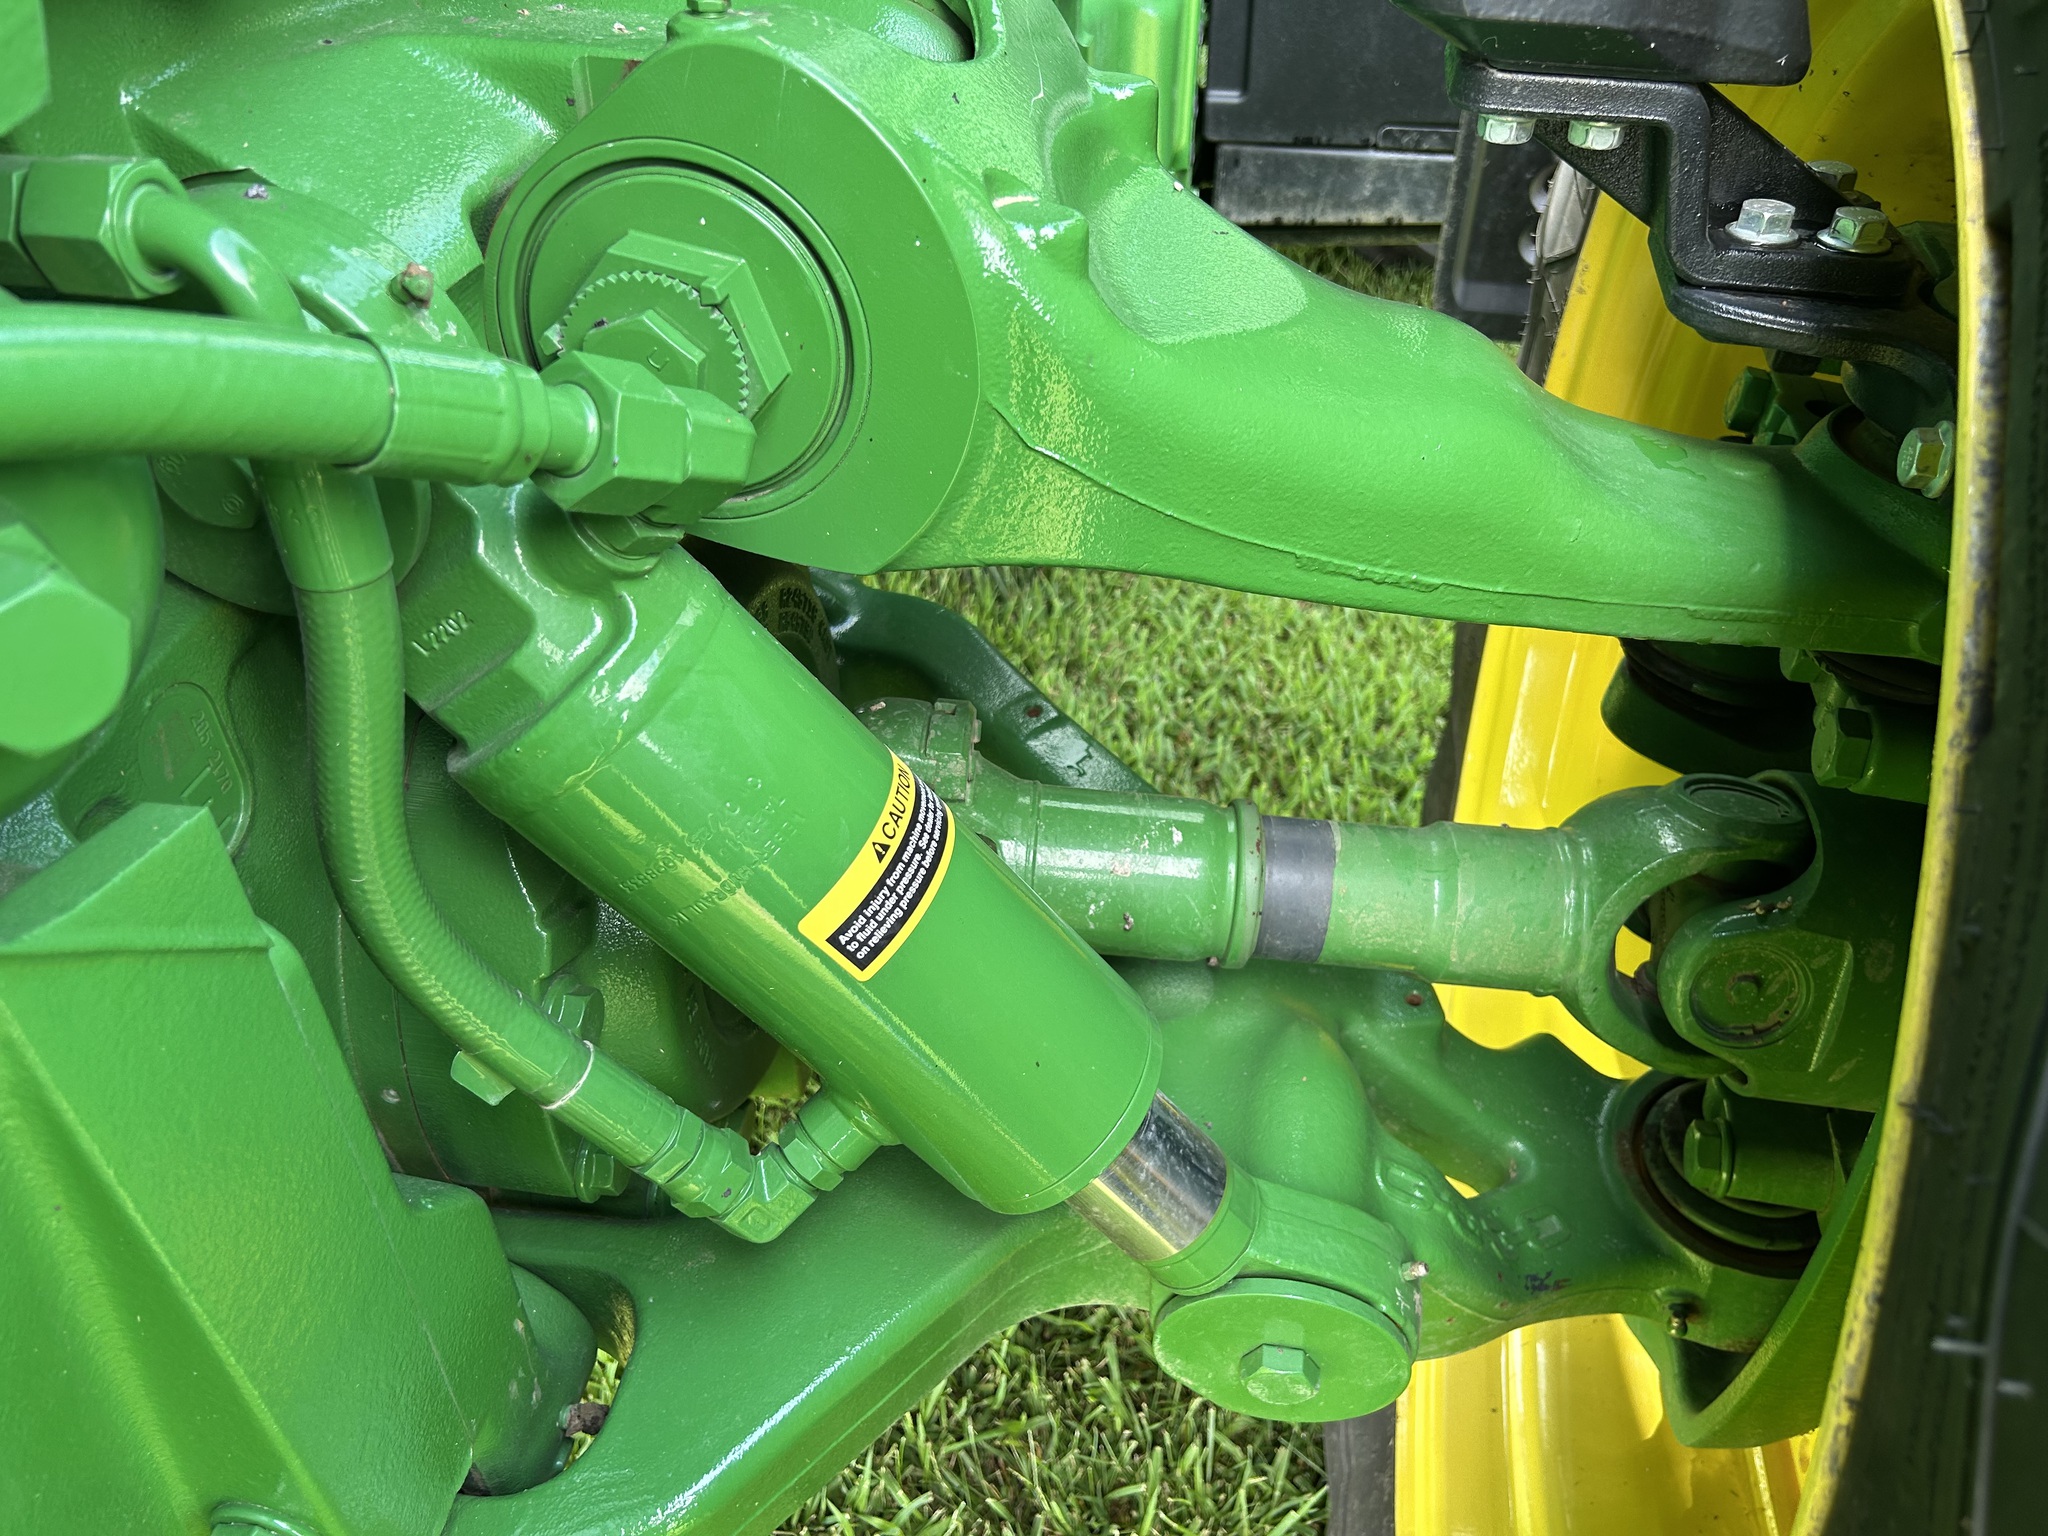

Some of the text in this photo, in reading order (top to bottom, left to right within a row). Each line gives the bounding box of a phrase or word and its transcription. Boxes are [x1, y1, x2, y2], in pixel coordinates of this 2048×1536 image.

[882, 763, 910, 839] CAUTION
[839, 914, 867, 945] Avoid
[863, 886, 890, 917] injury
[886, 862, 905, 887] from
[902, 822, 922, 863] machine
[846, 941, 859, 952] to
[856, 919, 878, 942] fluid
[875, 892, 898, 921] under
[895, 853, 923, 895] pressure.
[918, 832, 930, 849] See
[925, 809, 934, 833] dealer
[856, 946, 870, 959] on
[868, 907, 903, 947] relieving
[899, 867, 926, 910] pressure
[921, 840, 938, 868] before
[933, 808, 944, 841] servicing
